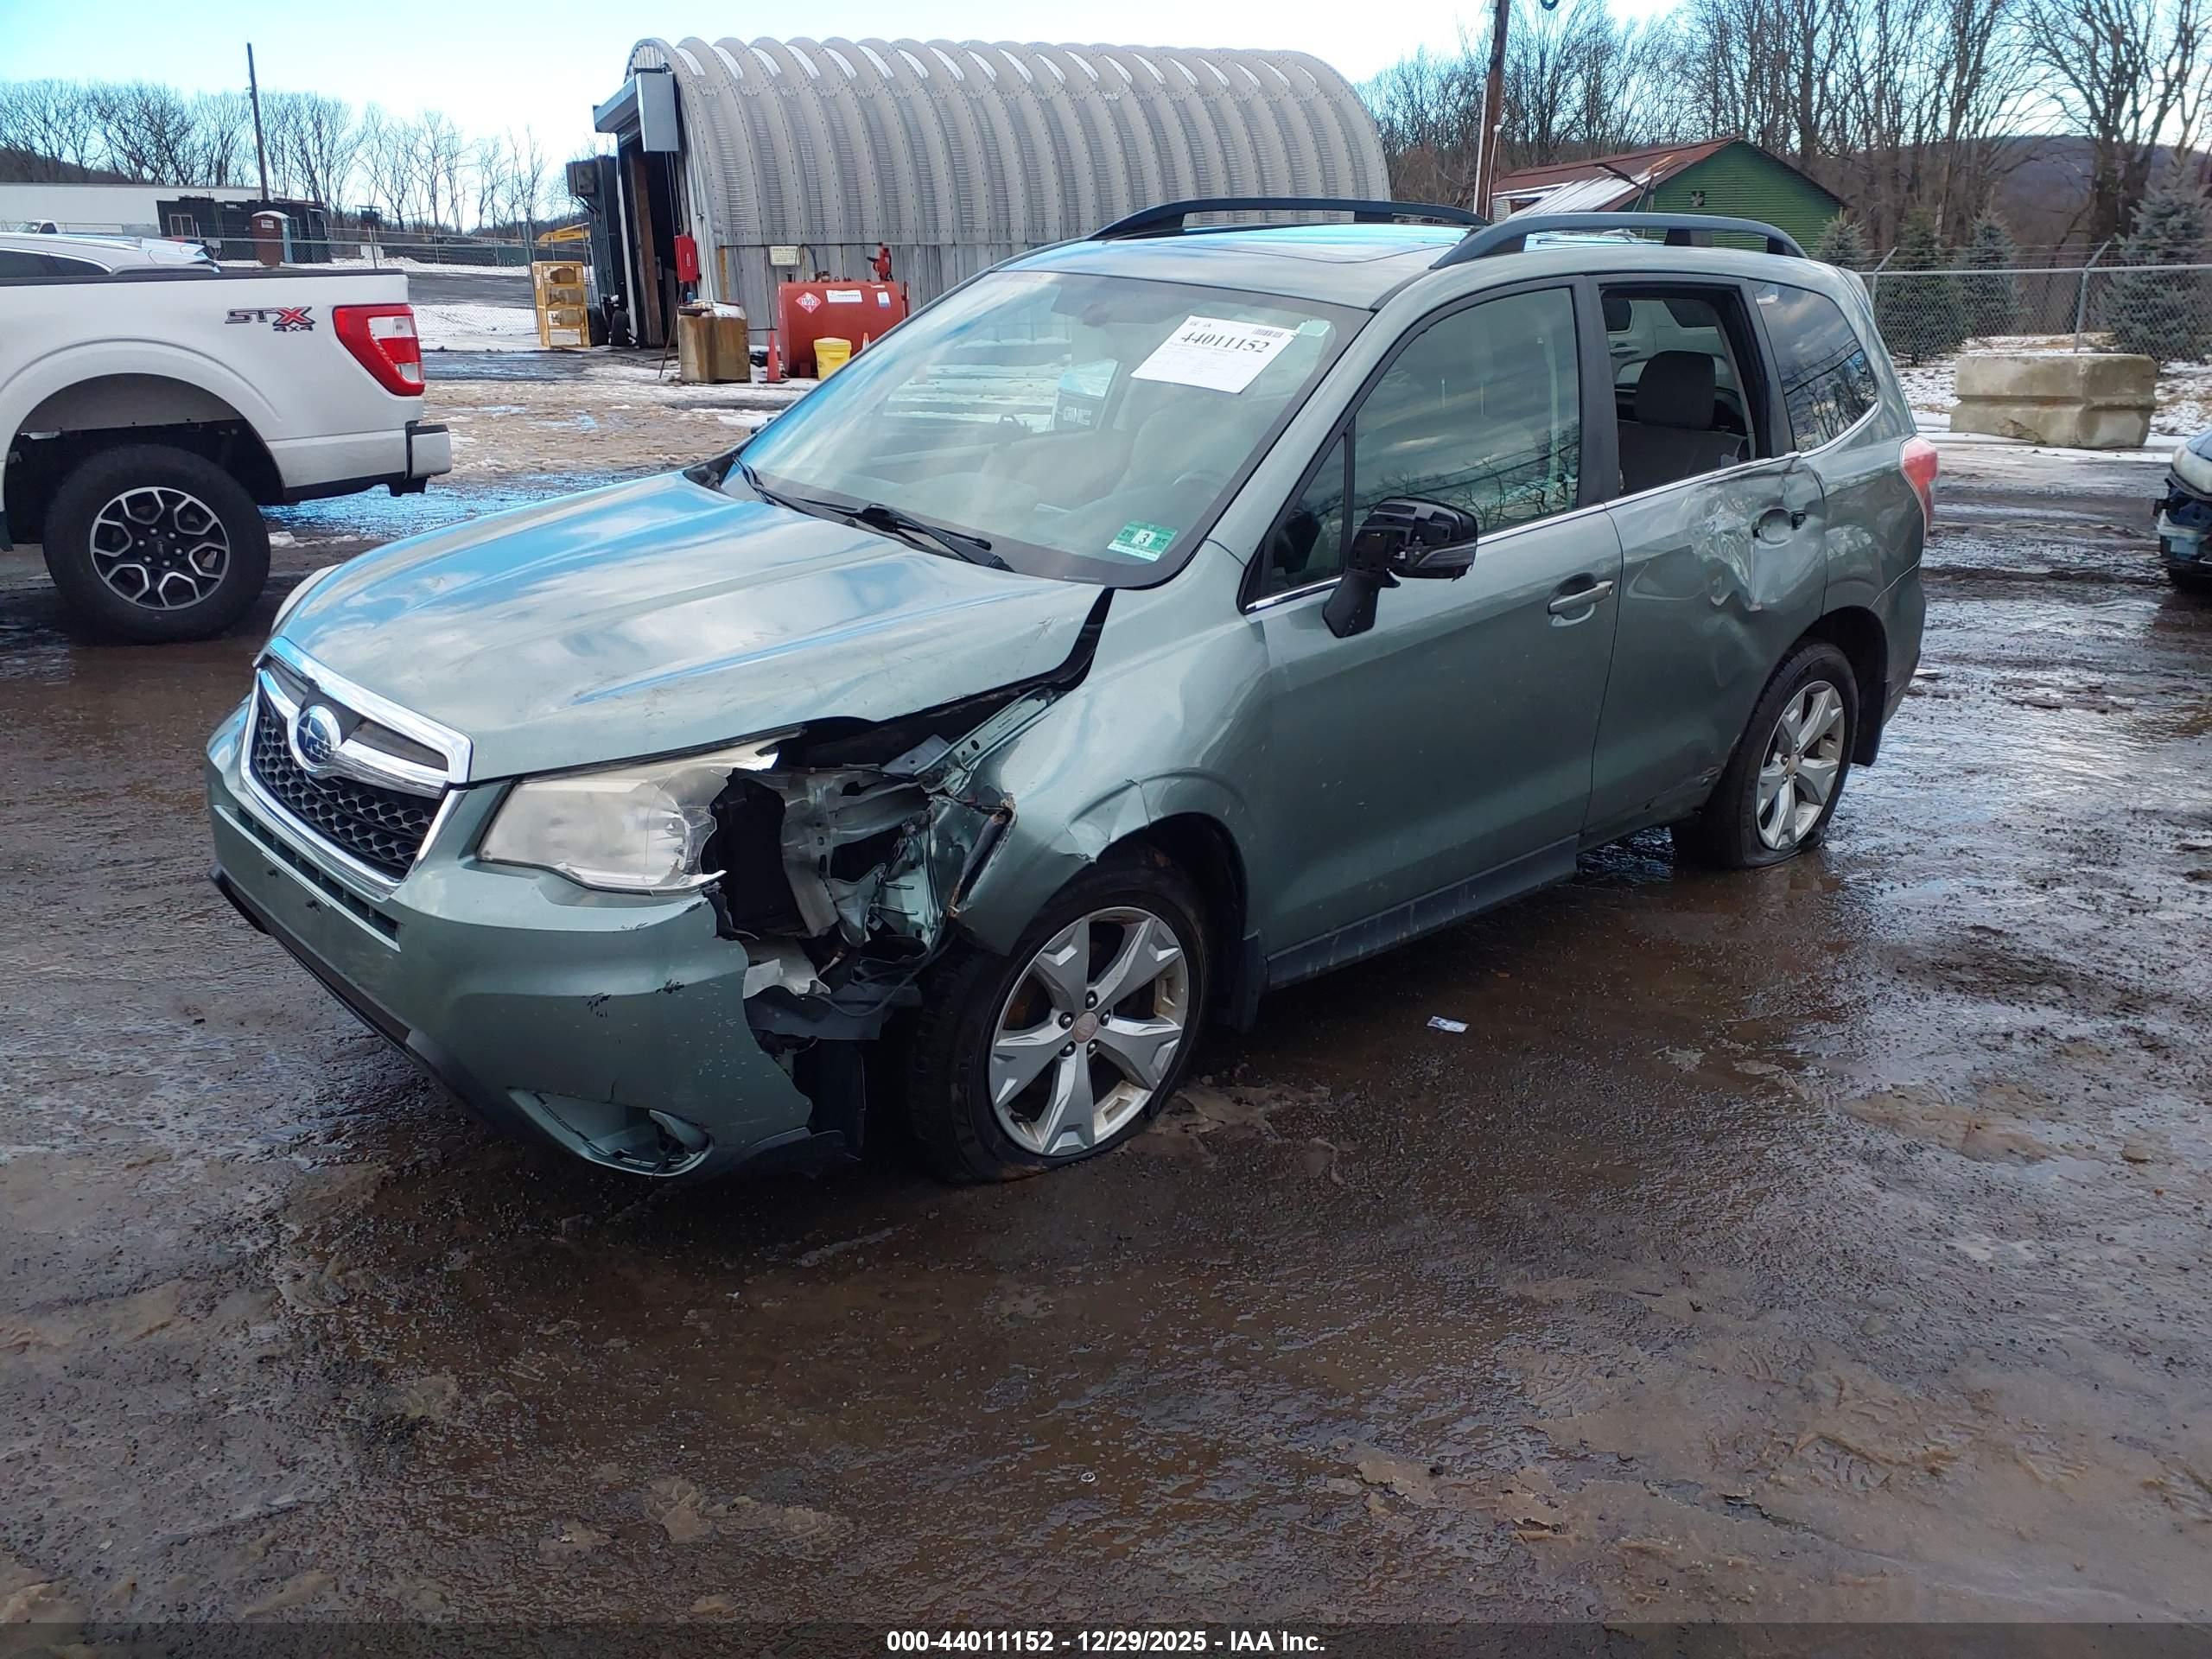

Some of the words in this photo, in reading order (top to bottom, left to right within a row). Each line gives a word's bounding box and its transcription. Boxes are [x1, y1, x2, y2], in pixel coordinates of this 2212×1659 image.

[225, 307, 316, 327] STX
[1181, 331, 1271, 353] 44011152
[1138, 532, 1150, 544] 3
